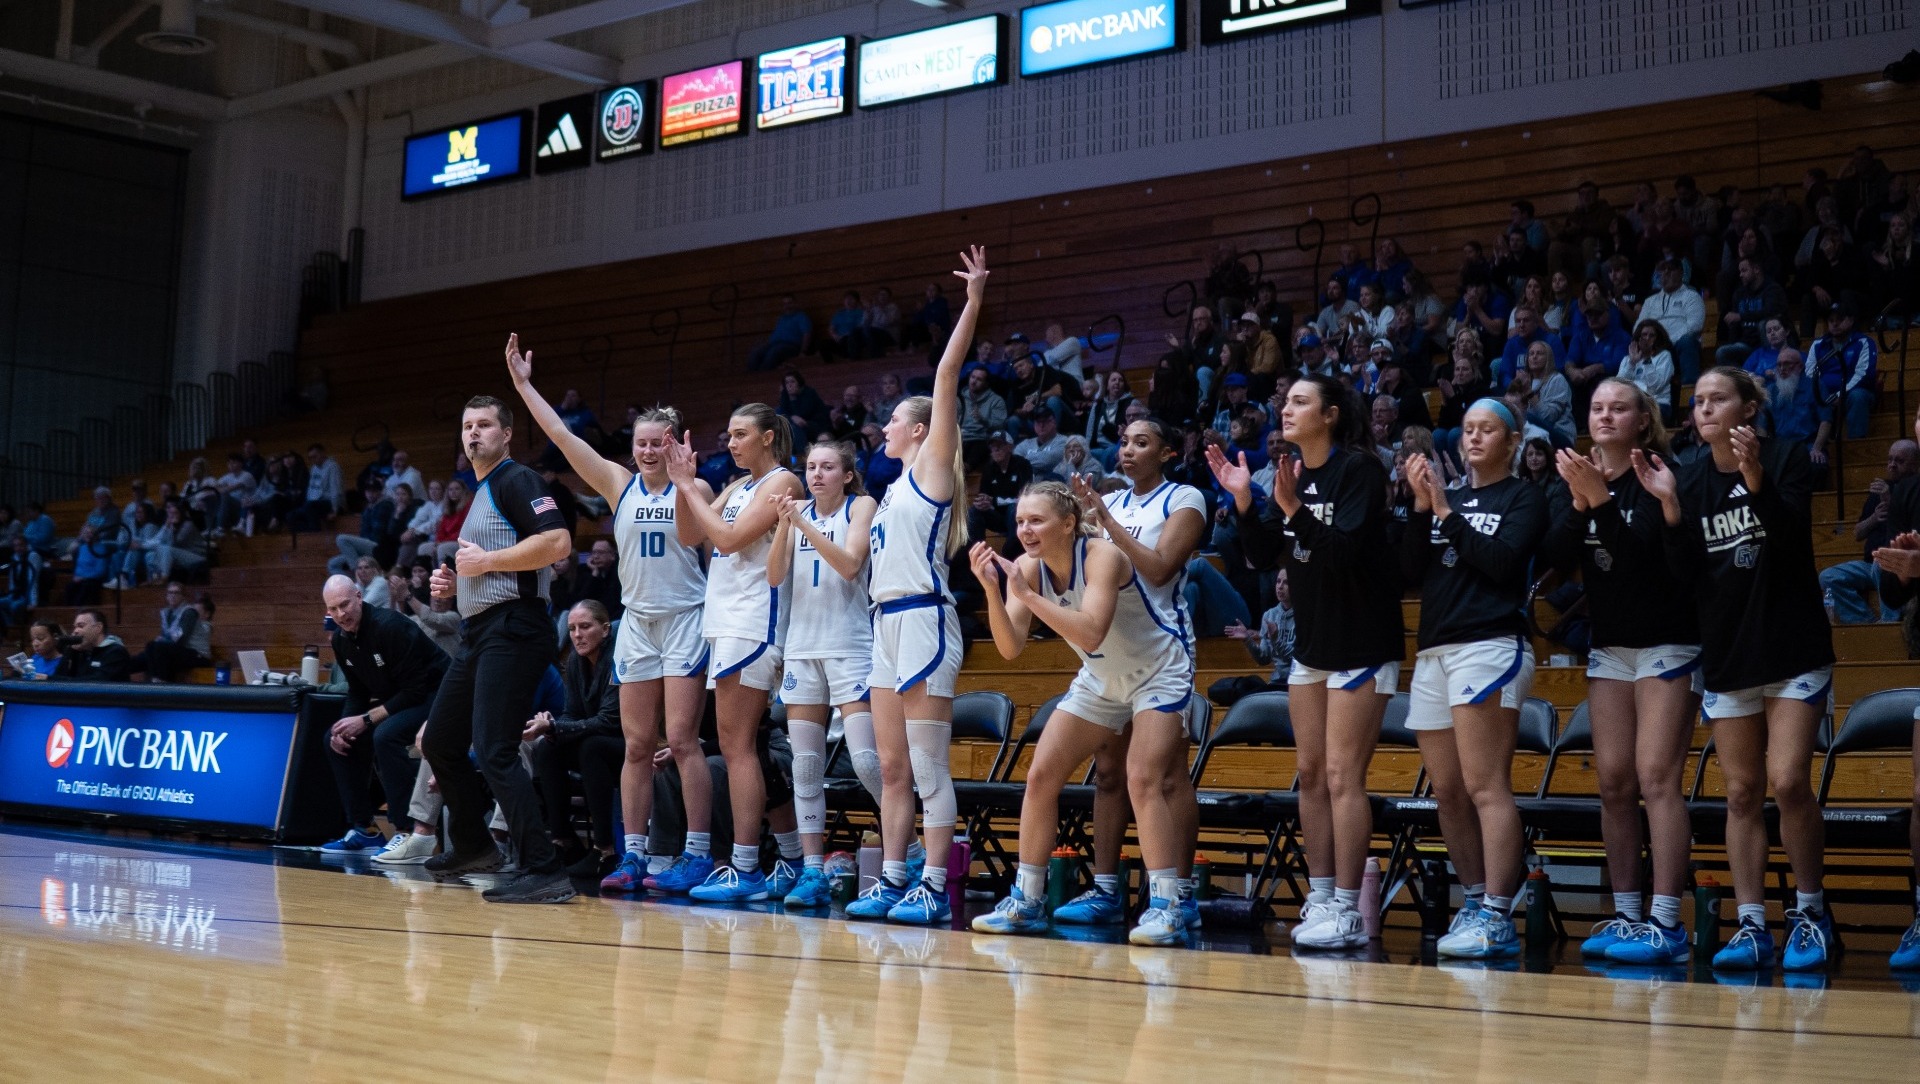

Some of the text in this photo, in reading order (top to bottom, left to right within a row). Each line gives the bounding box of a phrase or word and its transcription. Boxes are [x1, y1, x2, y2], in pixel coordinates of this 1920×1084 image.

[924, 45, 964, 75] WEST
[759, 55, 845, 113] TICKET
[693, 94, 736, 115] PIZZA
[448, 126, 478, 163] M
[635, 507, 675, 520] GVSU
[1701, 505, 1761, 542] LAKE
[640, 531, 666, 558] 10
[812, 559, 820, 588] 1
[57, 779, 195, 805] The Official Bank of GVSU Athletics
[1823, 812, 1887, 822] ulakers.com
